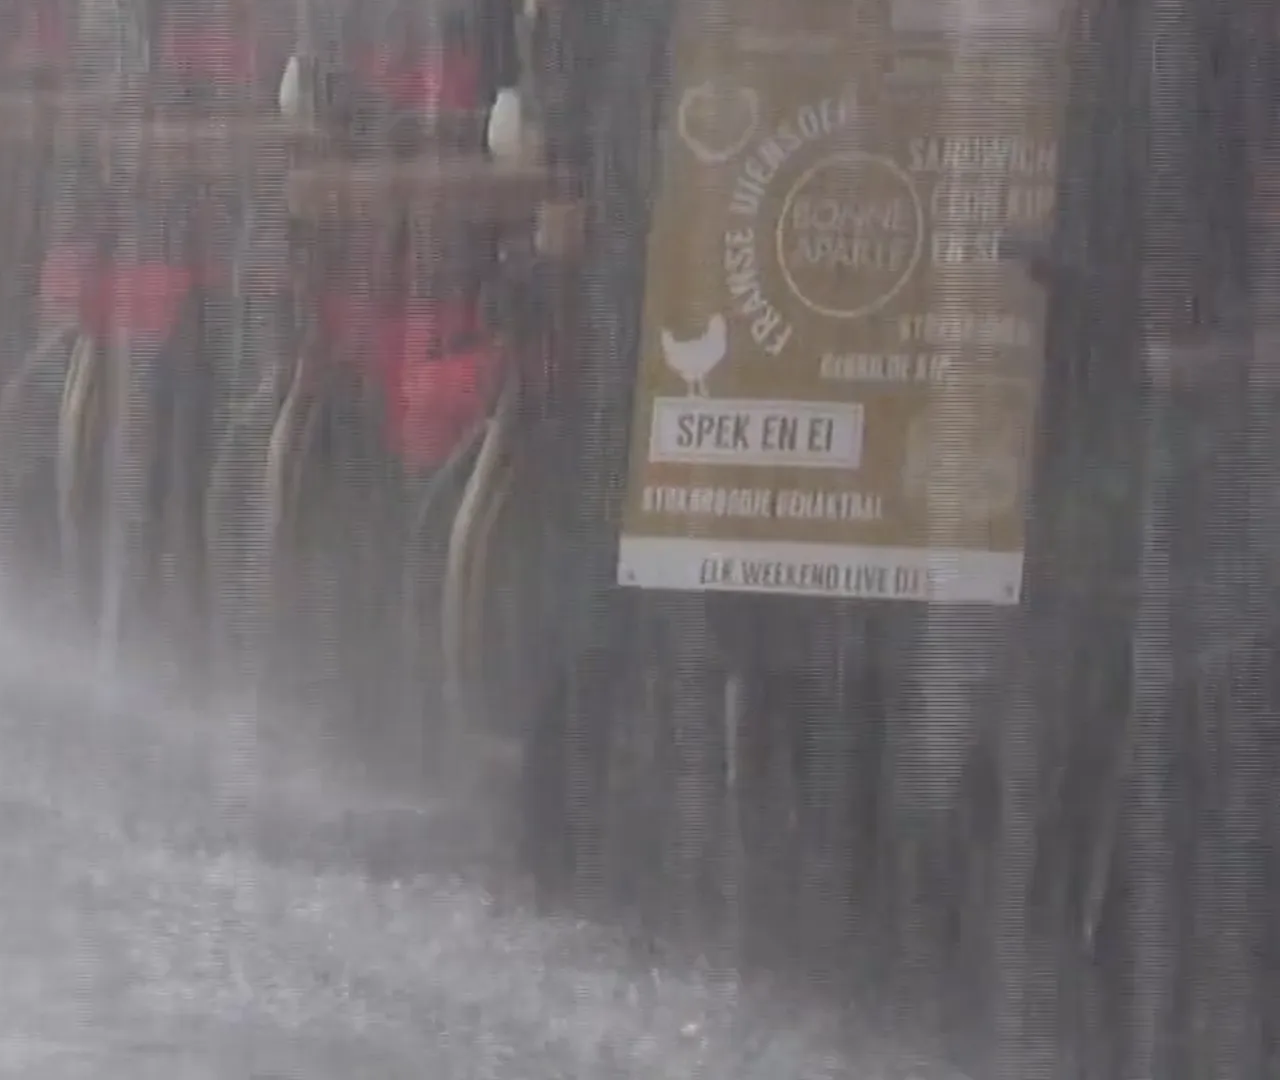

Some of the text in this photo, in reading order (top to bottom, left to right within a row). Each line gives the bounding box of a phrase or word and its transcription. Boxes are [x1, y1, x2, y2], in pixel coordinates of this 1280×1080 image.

[675, 412, 835, 453] SPEK EN EI
[741, 560, 840, 591] WEEKEND
[844, 564, 889, 594] LIVE
